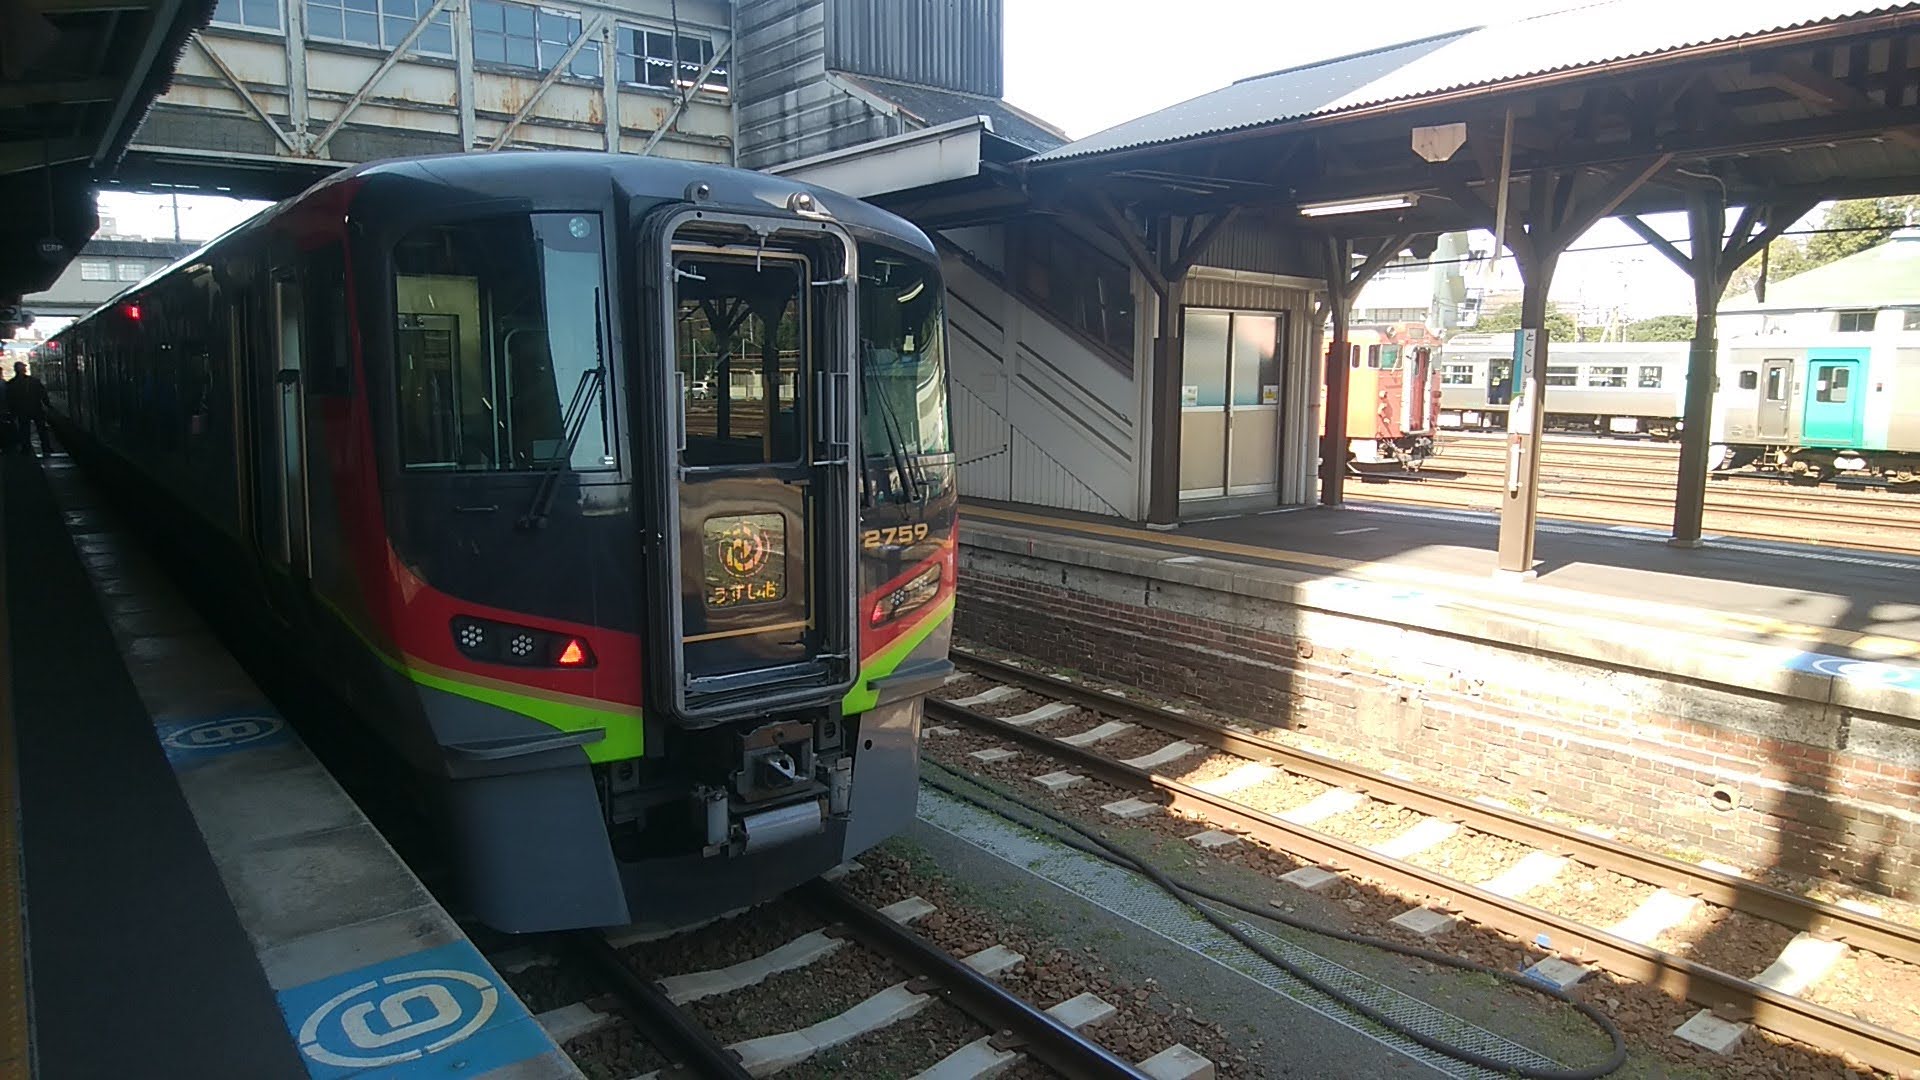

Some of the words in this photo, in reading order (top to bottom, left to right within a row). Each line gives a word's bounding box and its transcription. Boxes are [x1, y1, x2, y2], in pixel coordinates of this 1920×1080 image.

[864, 523, 929, 549] 2759
[714, 581, 779, 604] うずしお
